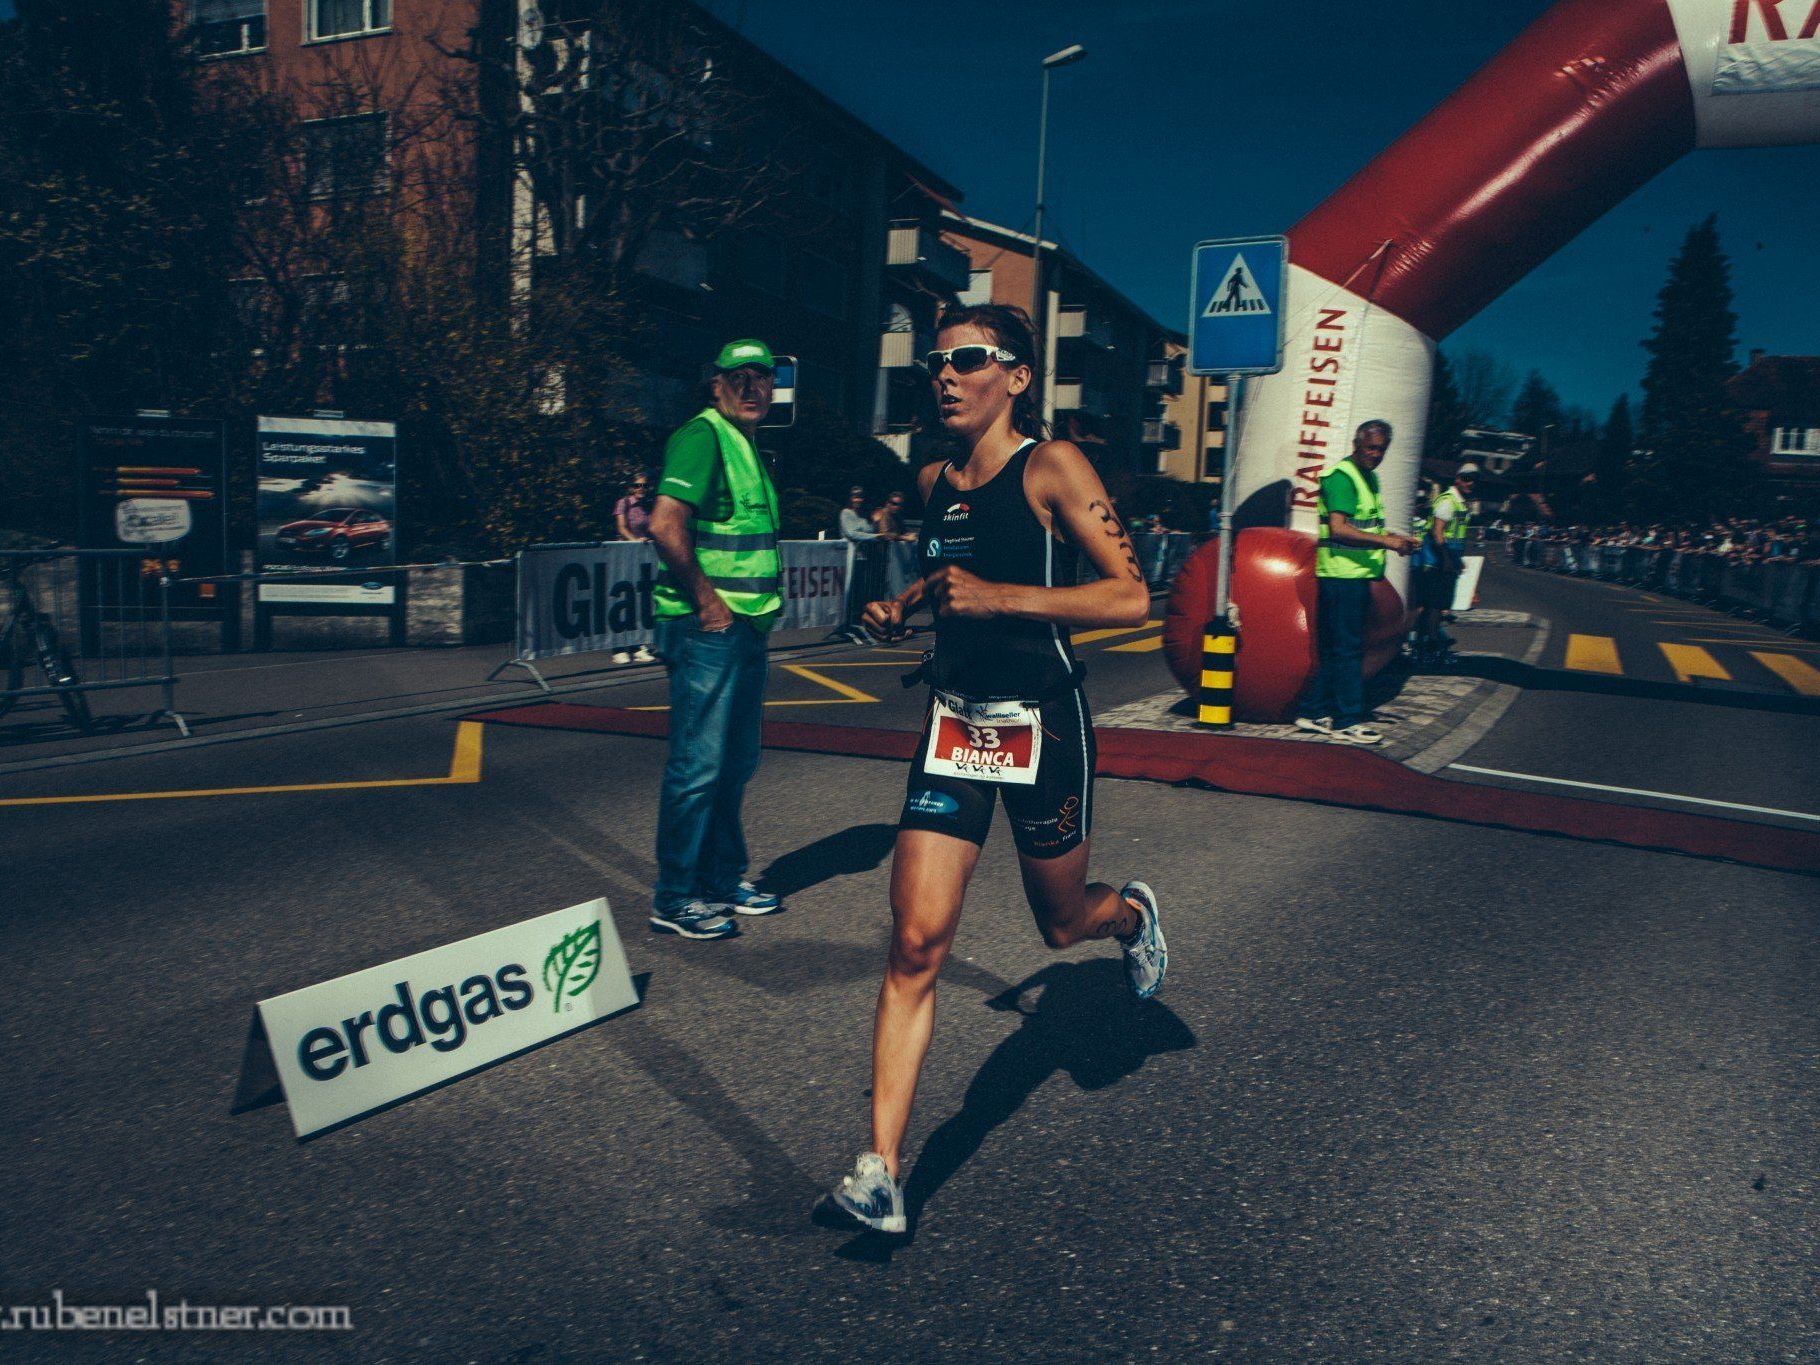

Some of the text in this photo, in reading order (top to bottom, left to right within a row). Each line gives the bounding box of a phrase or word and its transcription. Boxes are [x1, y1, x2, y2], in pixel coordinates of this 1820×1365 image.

[1289, 308, 1347, 509] RAIFFEISEN
[943, 512, 969, 521] skinfit
[967, 726, 1001, 749] 33
[951, 746, 1015, 767] BIANCA
[299, 963, 535, 1082] erdgas
